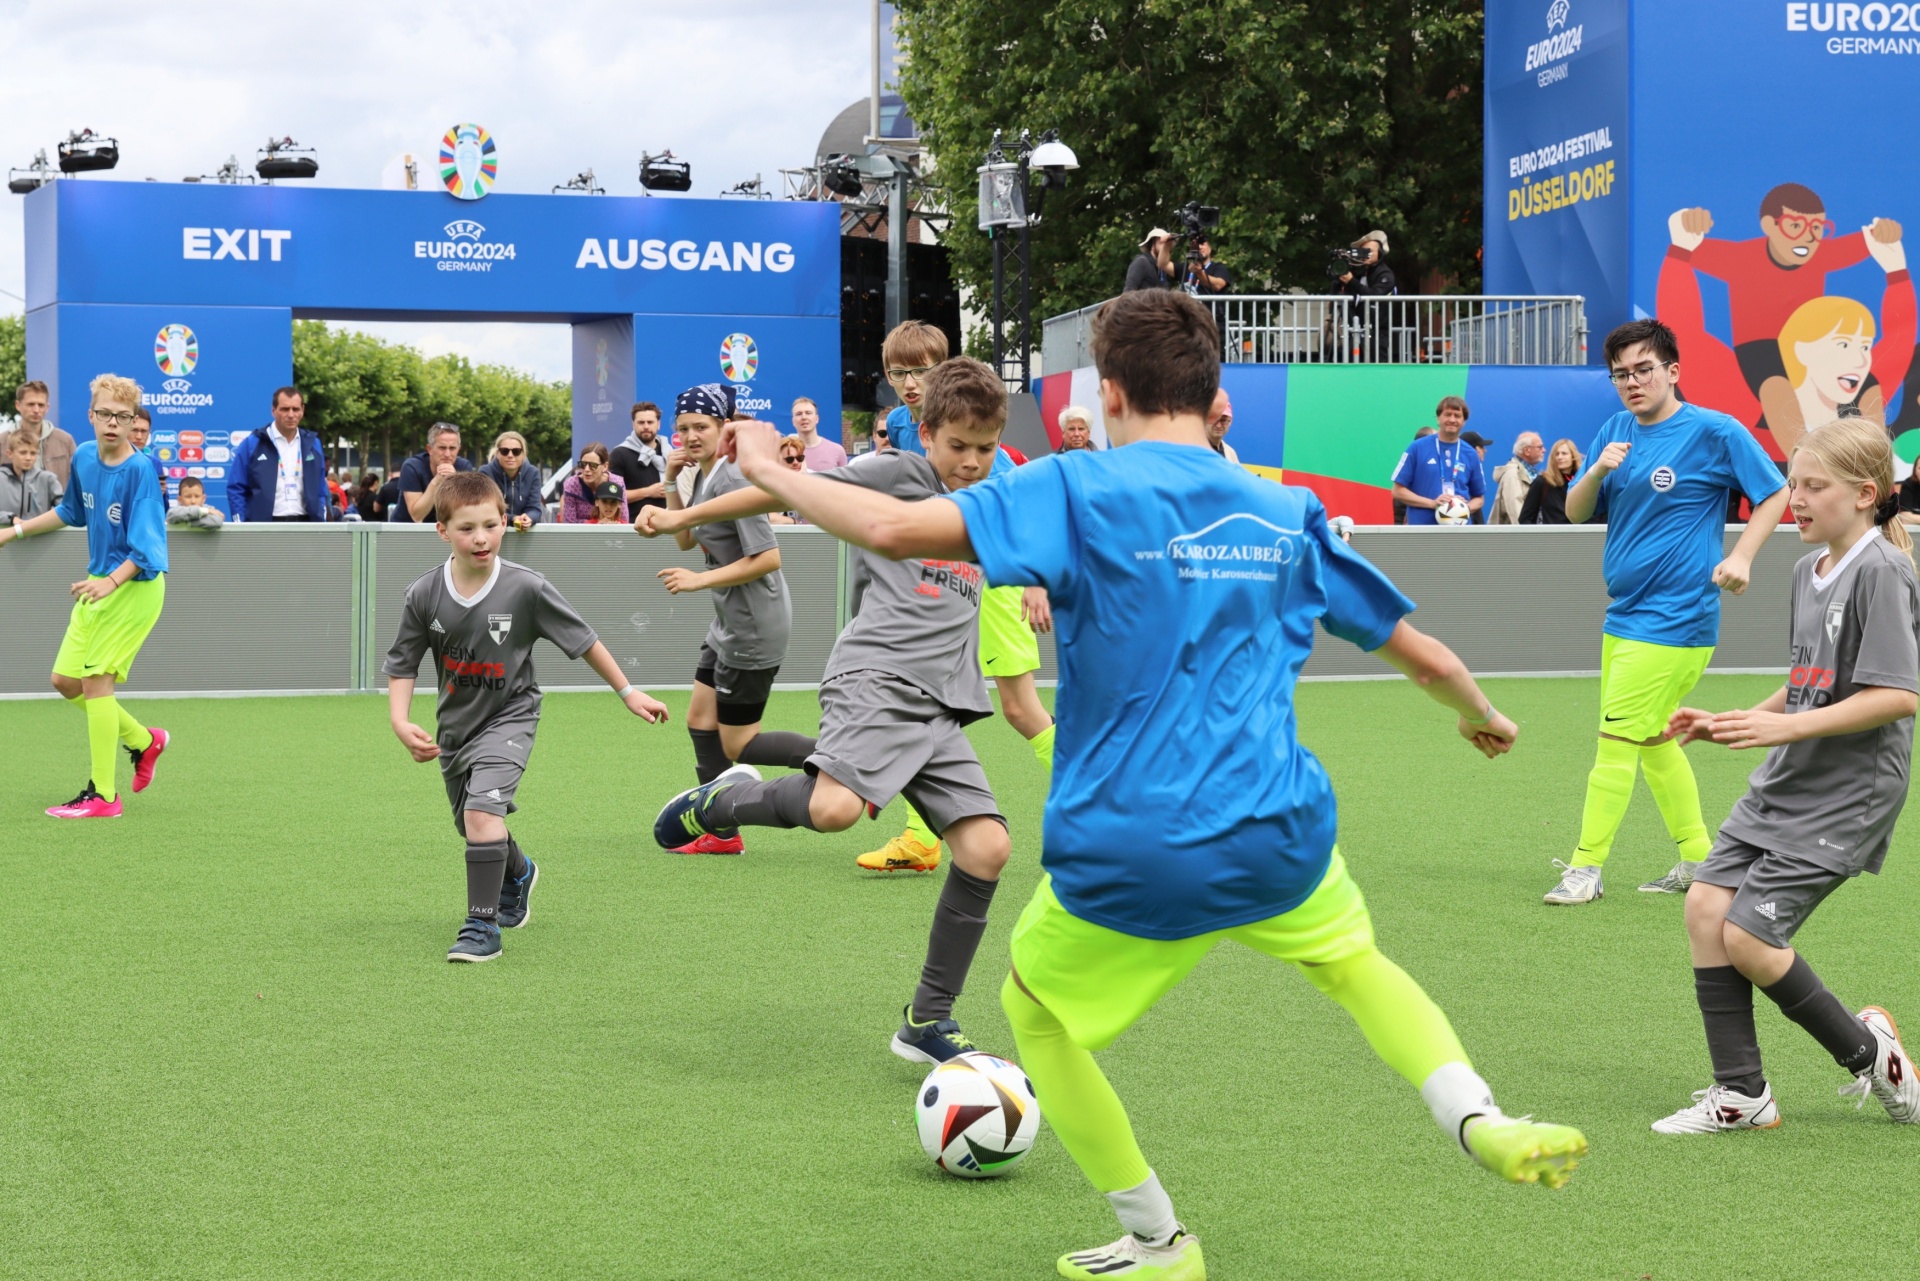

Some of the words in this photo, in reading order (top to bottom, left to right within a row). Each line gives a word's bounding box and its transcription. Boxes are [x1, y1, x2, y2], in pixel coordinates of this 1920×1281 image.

[1546, 2, 1569, 30] UEFA
[1525, 24, 1583, 72] EURO2024
[1826, 37, 1920, 55] GERMANY
[1537, 62, 1568, 88] GERMANY
[1509, 150, 1538, 179] EURO
[1537, 142, 1565, 170] 2024
[1564, 126, 1613, 162] FESTIVAL
[1508, 159, 1615, 222] DÜSSELDORF
[445, 222, 483, 240] UEFA
[183, 227, 292, 262] EXIT
[414, 241, 517, 260] EURO2024
[575, 238, 796, 273] AUSGANG
[436, 260, 493, 273] GERMANY
[163, 379, 191, 393] UEFA
[141, 393, 214, 406] EURO2024
[735, 398, 772, 410] O2024
[156, 406, 197, 415] GERMANY
[1172, 543, 1283, 564] KAROZAUBER
[920, 565, 978, 608] FREUND
[1791, 645, 1813, 665] EIN
[469, 905, 494, 915] JAKO
